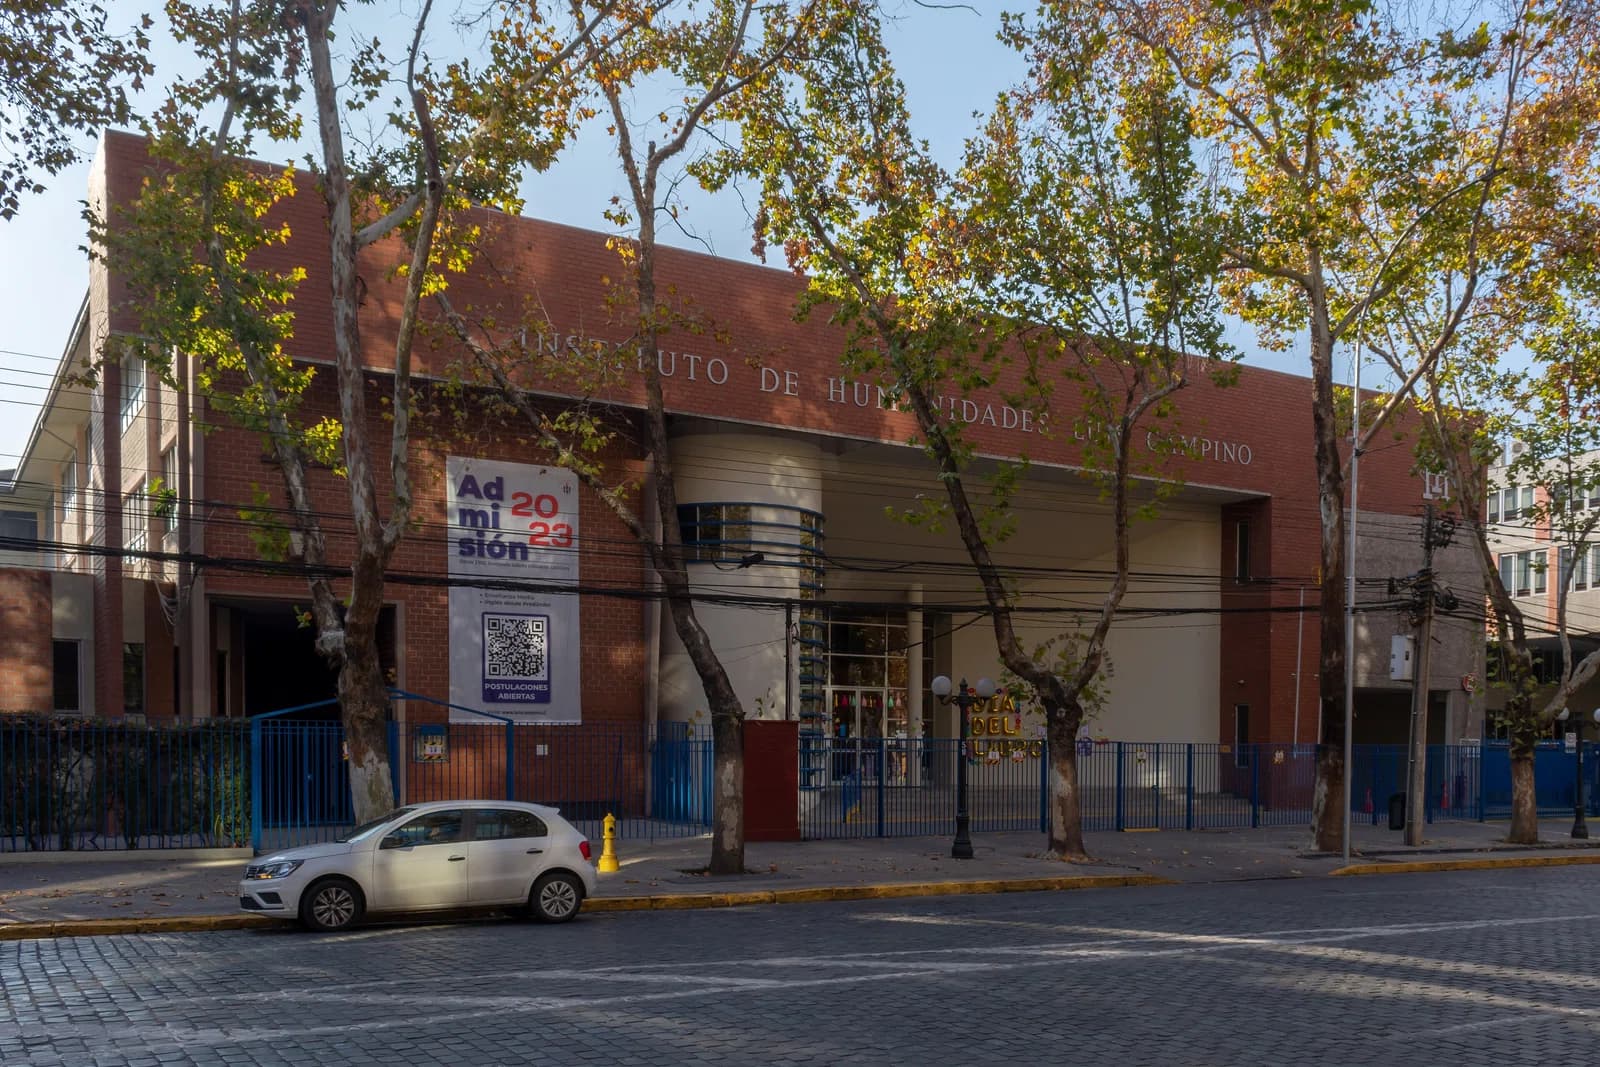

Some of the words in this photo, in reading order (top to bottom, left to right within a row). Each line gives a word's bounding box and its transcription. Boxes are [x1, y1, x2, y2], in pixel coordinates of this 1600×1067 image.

[760, 367, 799, 396] DE
[827, 376, 1049, 434] HUMNIDADES
[457, 474, 504, 501] Ad
[458, 502, 500, 529] mi
[511, 491, 559, 518] 20
[459, 530, 529, 560] sión
[528, 521, 573, 548] 23
[484, 683, 548, 691] POSTULACIONES
[498, 692, 535, 700] ABIERTAS
[972, 716, 1016, 735] DEL
